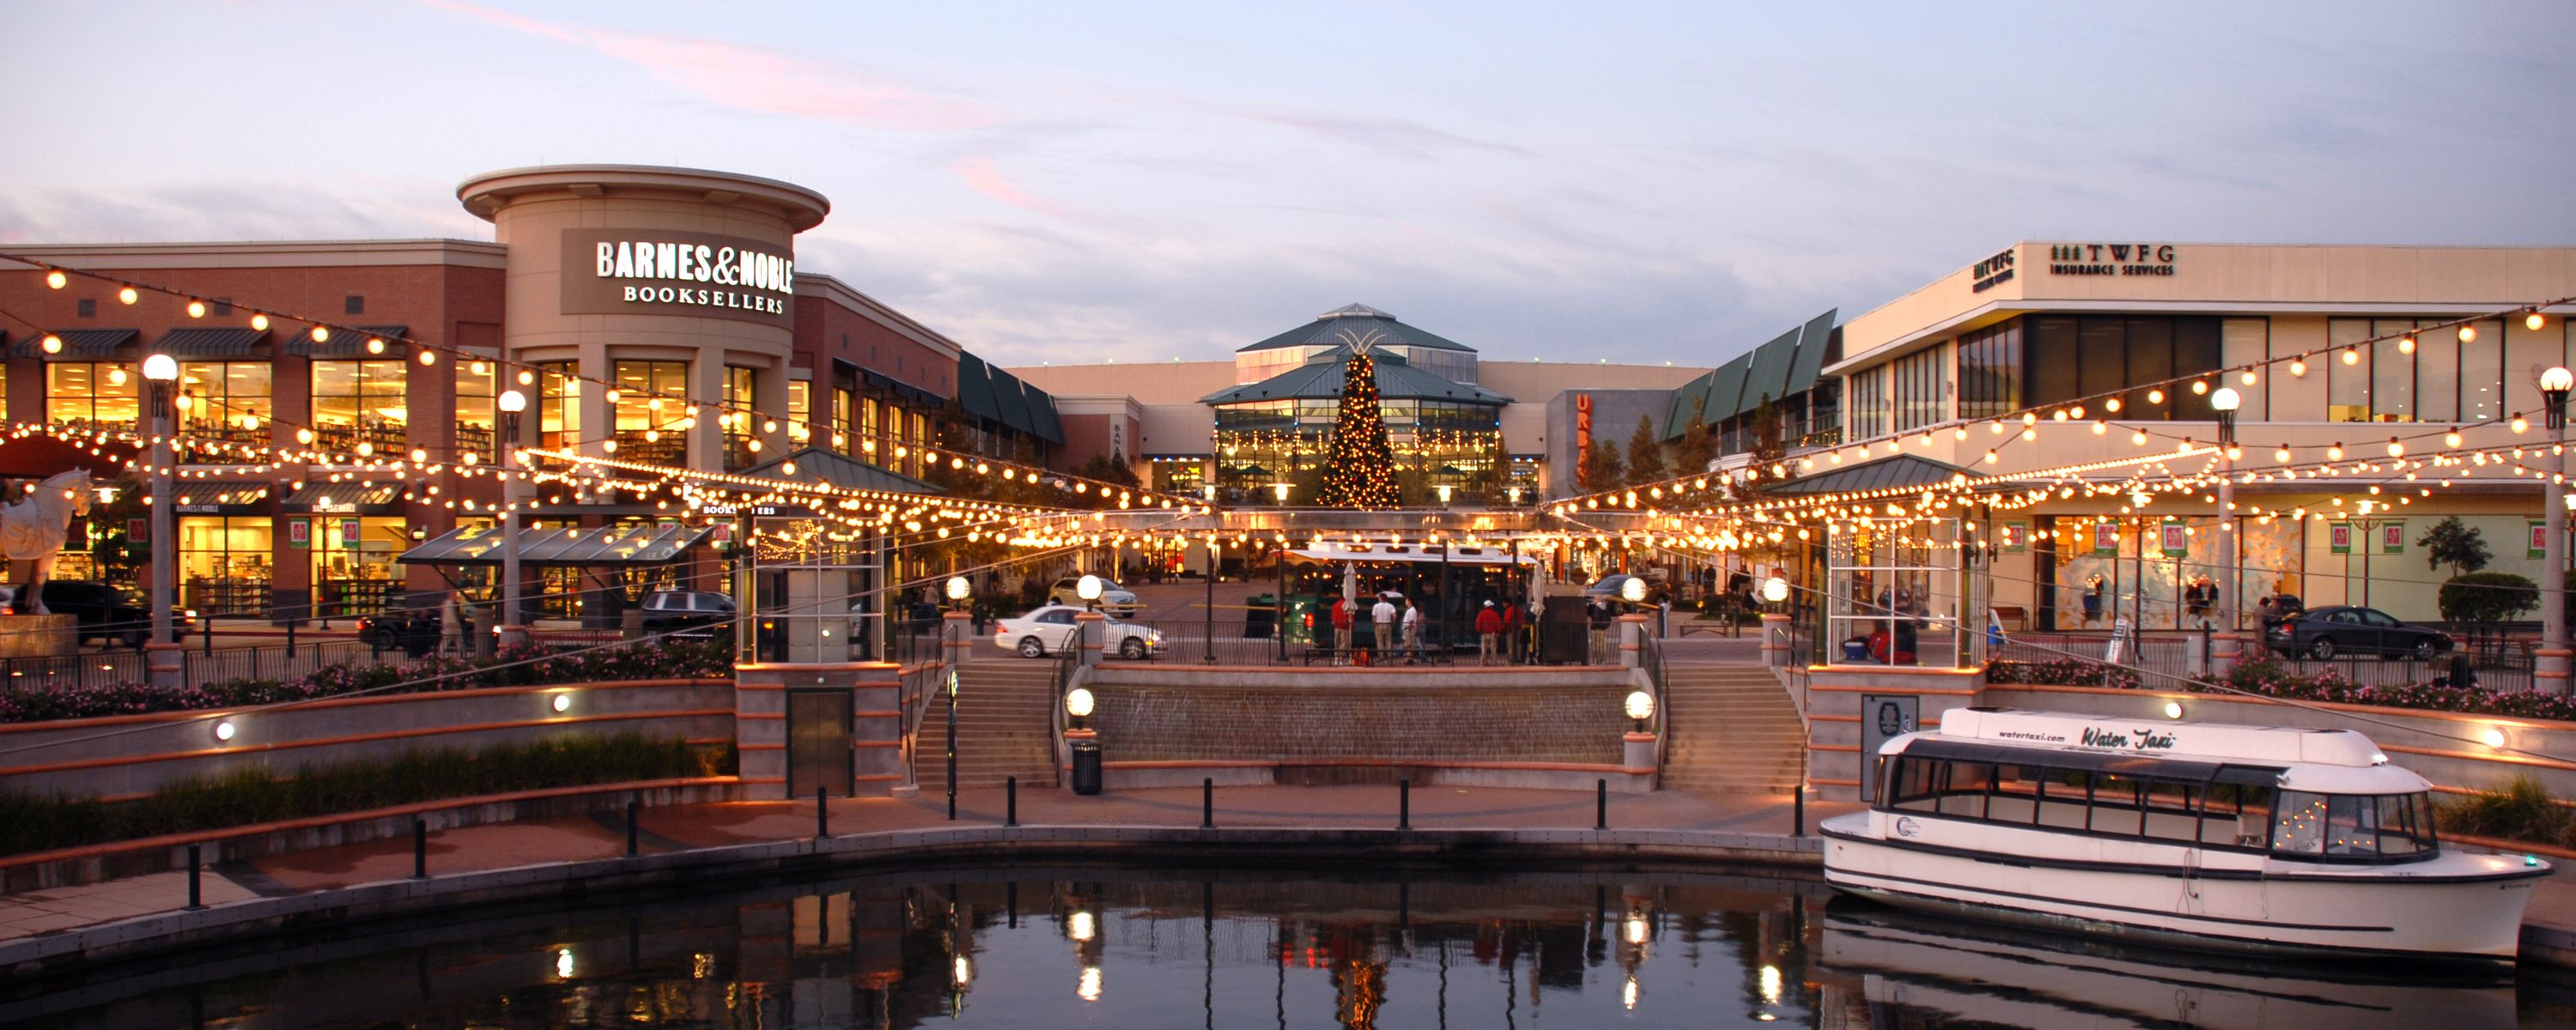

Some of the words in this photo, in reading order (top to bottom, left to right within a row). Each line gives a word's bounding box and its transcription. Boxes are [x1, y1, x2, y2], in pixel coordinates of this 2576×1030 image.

[1984, 248, 2014, 275] TWFG
[2087, 244, 2174, 263] TWFG
[597, 241, 793, 294] BARNES&NOBLE
[2050, 264, 2115, 276] INSURANCE
[2122, 264, 2174, 276] SERVICES
[623, 286, 783, 314] BOOKSELLERS
[1998, 730, 2065, 742] watertaxi.com
[2081, 726, 2128, 748] Water
[2133, 729, 2173, 750] Taxi
